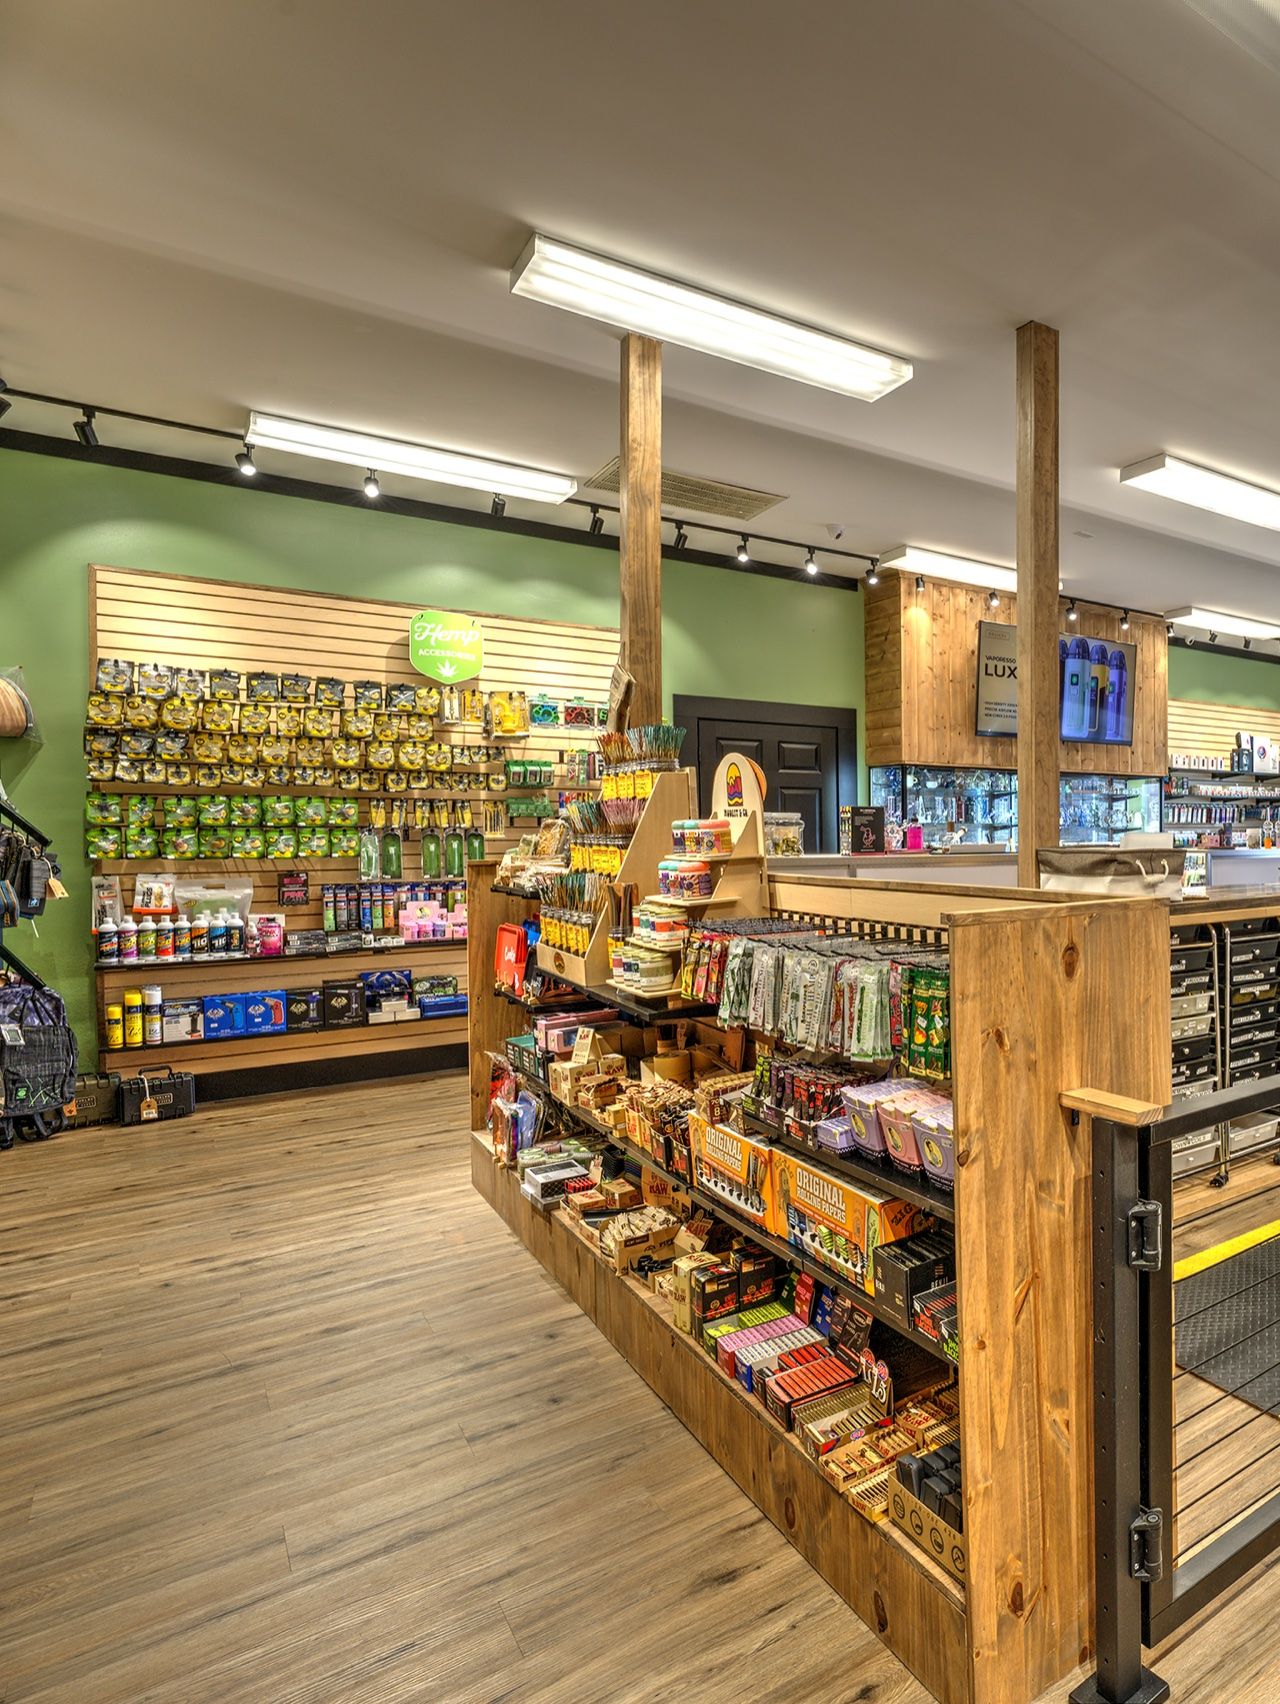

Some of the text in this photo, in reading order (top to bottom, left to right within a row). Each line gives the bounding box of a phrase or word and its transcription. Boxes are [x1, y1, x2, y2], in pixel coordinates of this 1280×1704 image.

[413, 621, 480, 646] Hemp
[985, 655, 1017, 664] VAPORESSO
[604, 1064, 625, 1076] RAW
[706, 1127, 742, 1160] ORIGINAL
[706, 1143, 725, 1164] ROLLING
[724, 1154, 742, 1172] PAPERS
[649, 1183, 669, 1196] RAW
[796, 1167, 846, 1211] ORIGINAL
[796, 1189, 821, 1212] ROLLING
[821, 1202, 846, 1224] PAPERS
[685, 1220, 712, 1237] RAW
